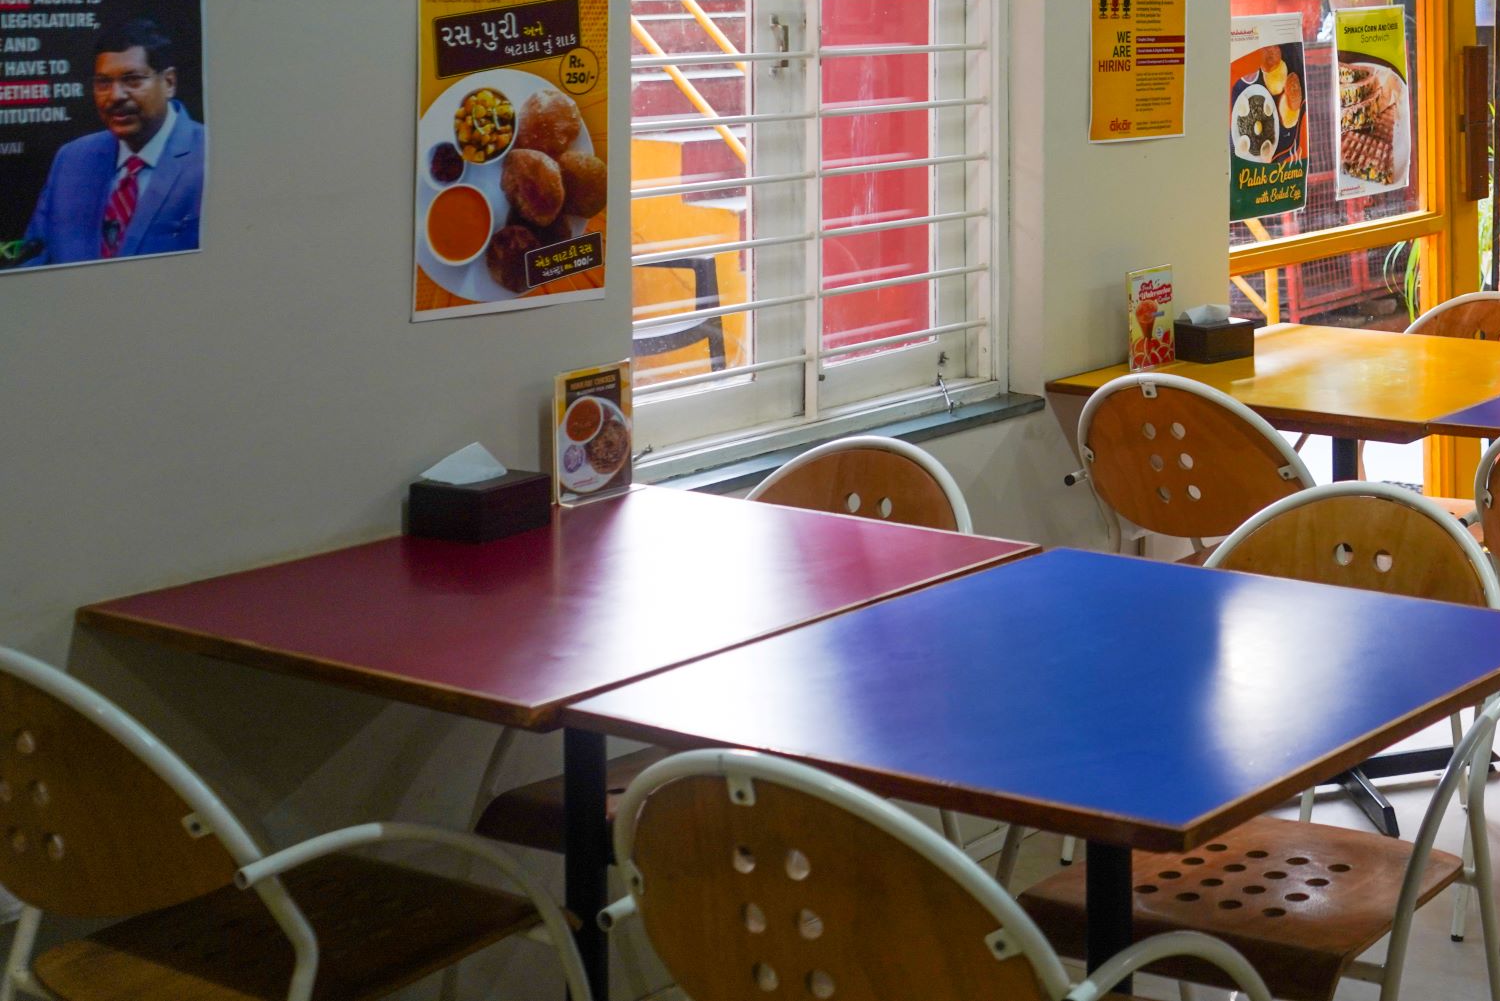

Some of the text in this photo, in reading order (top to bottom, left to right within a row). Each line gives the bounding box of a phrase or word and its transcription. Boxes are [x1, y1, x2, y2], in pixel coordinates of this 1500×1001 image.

[1, 12, 101, 30] LEGISLATURE,
[1116, 31, 1131, 43] WE
[4, 37, 41, 53] AND
[1112, 45, 1131, 58] ARE
[5, 59, 71, 76] HAVE TO
[569, 55, 585, 69] Rs.
[1098, 59, 1131, 73] HIRING
[565, 72, 596, 85] 250/-
[53, 83, 84, 99] FOR
[1239, 161, 1303, 189] Palak Keema
[1255, 189, 1269, 204] with
